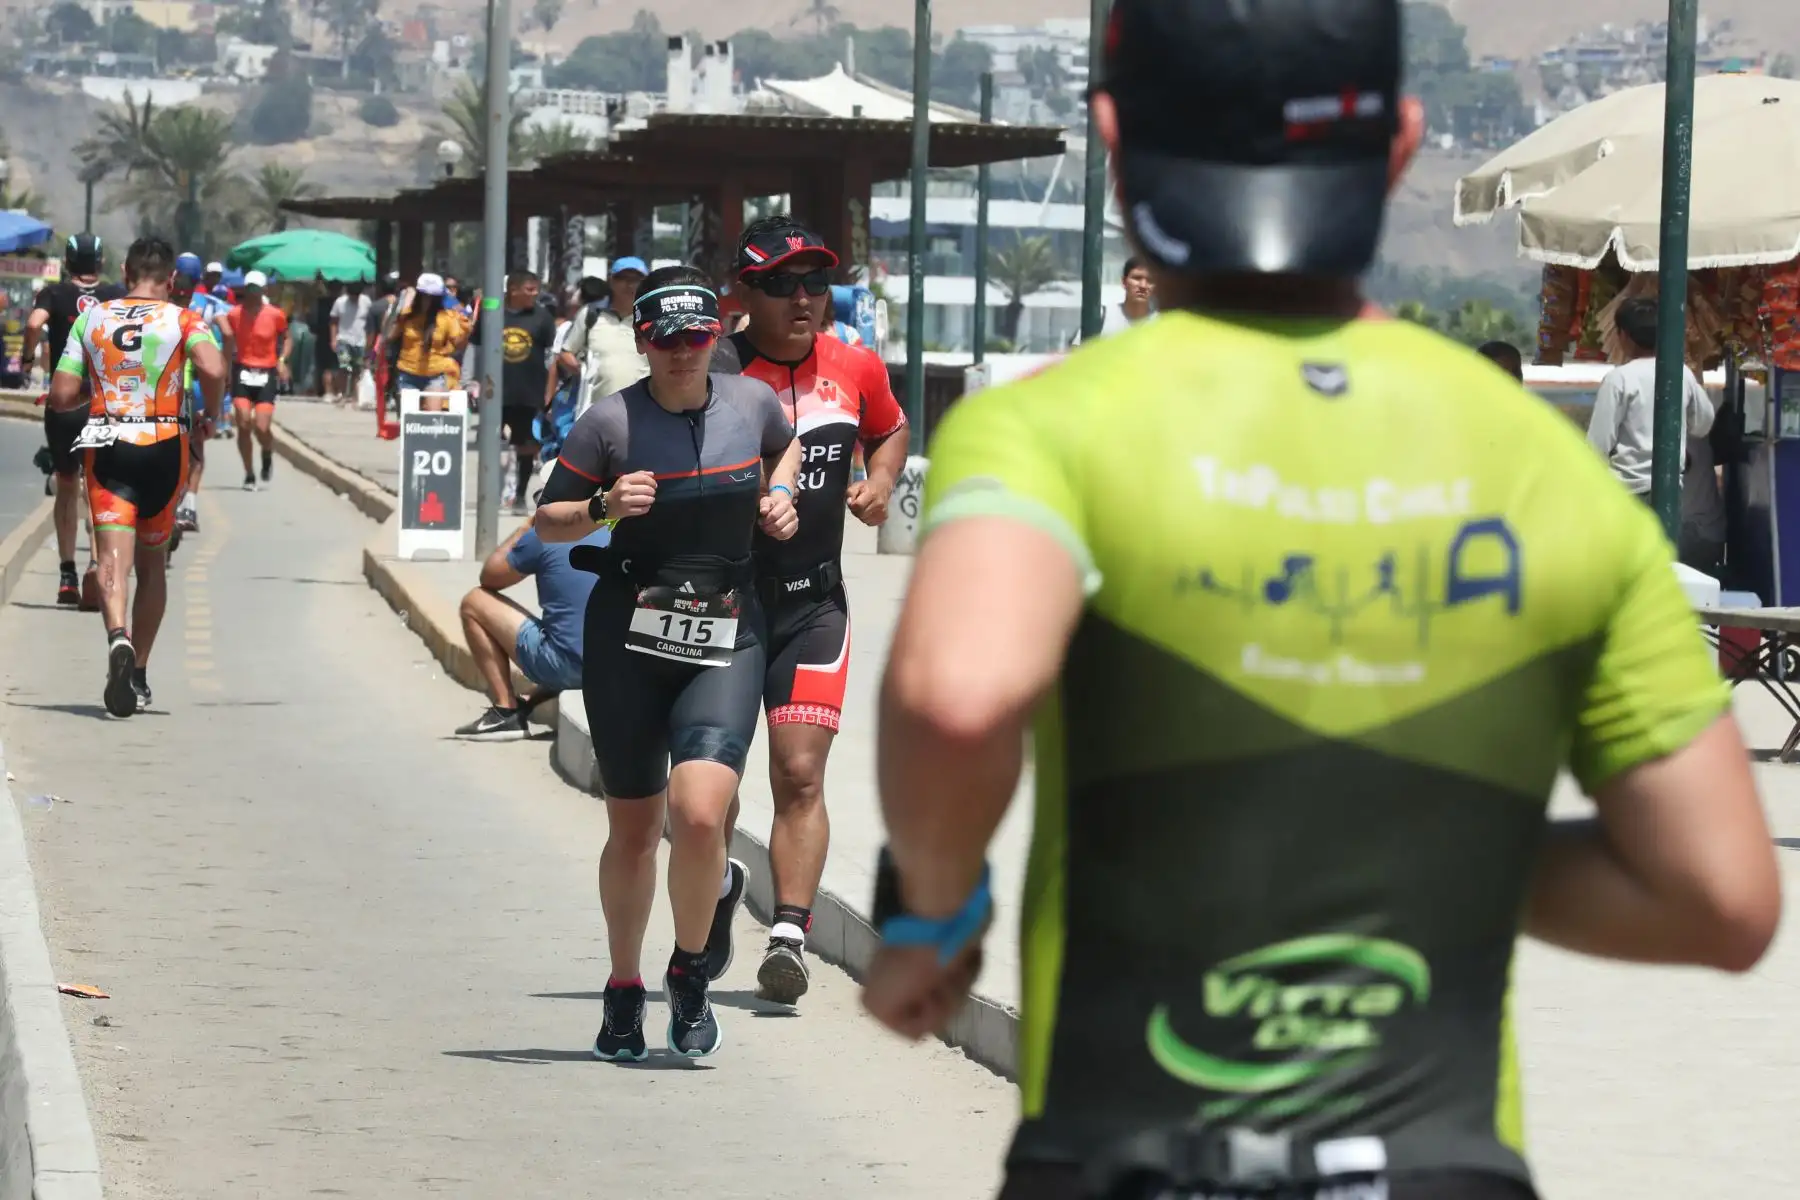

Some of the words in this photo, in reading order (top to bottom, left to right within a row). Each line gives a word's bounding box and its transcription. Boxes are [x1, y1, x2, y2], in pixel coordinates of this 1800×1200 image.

[660, 293, 703, 306] IRONMAN
[661, 303, 678, 313] 70.3
[112, 324, 143, 352] G
[405, 422, 460, 435] Kilometer
[413, 450, 452, 476] 20
[784, 578, 811, 592] VISA
[659, 614, 714, 644] 115
[656, 641, 703, 657] CAROLINA
